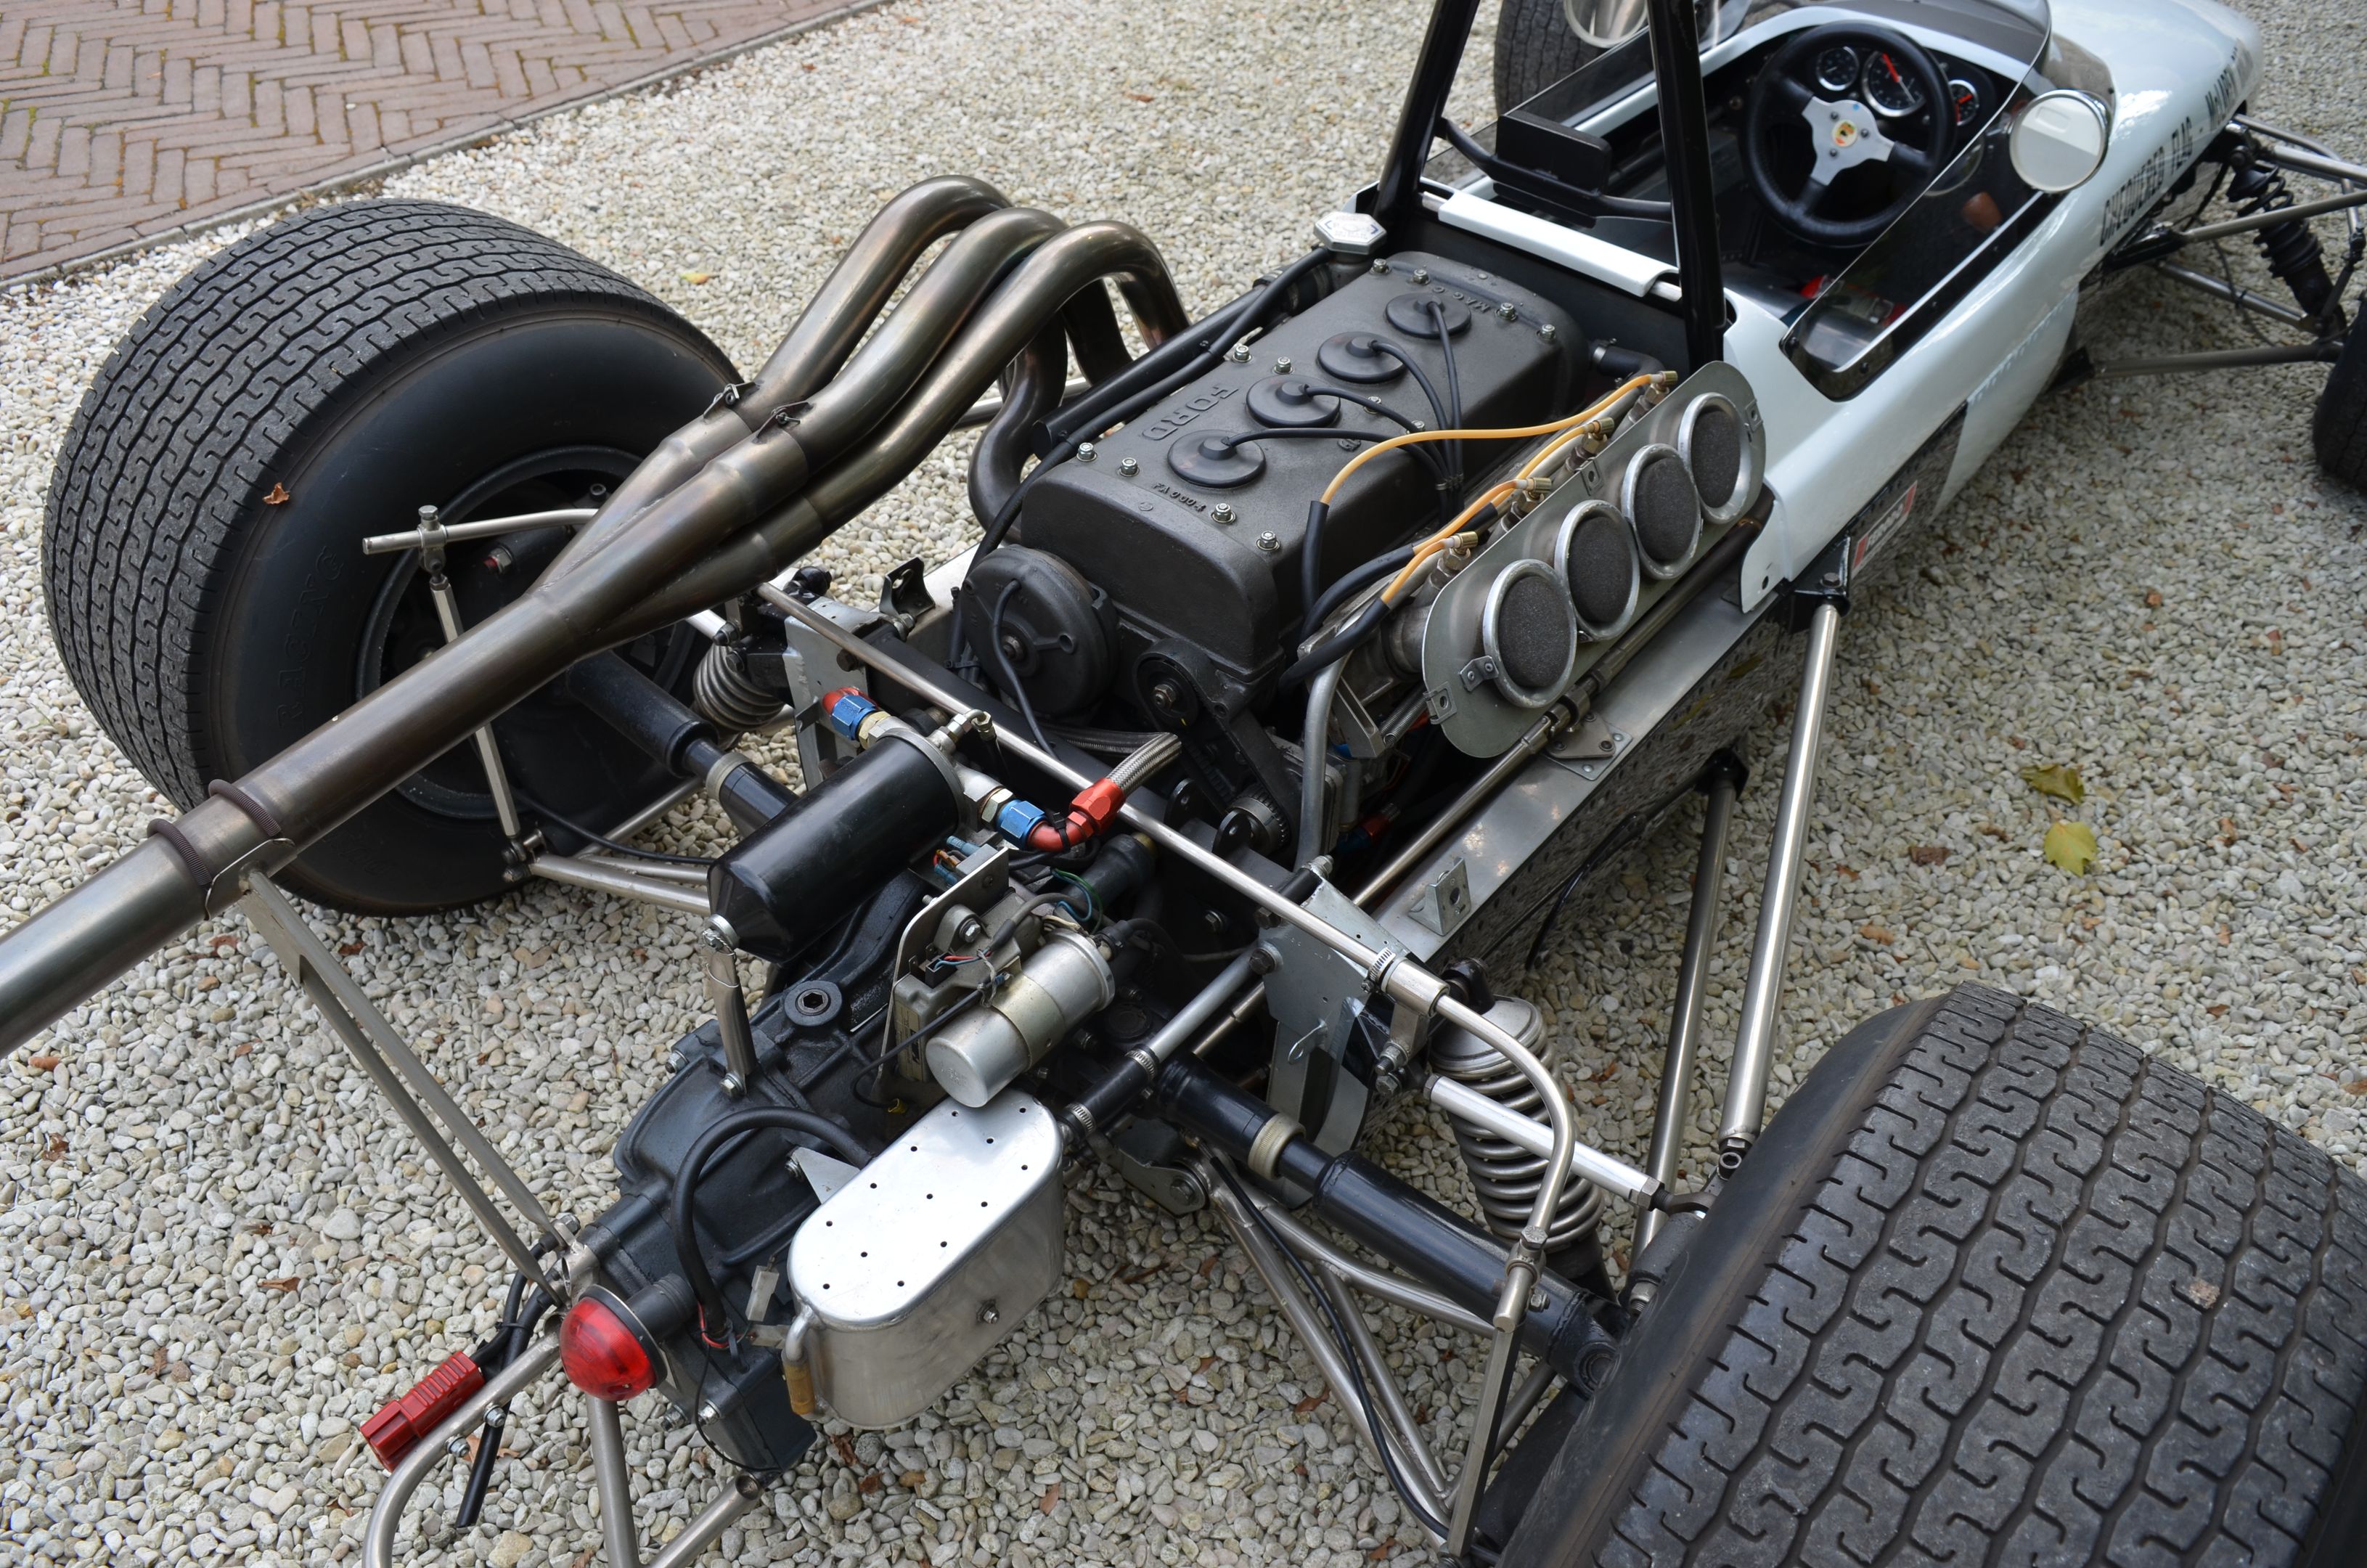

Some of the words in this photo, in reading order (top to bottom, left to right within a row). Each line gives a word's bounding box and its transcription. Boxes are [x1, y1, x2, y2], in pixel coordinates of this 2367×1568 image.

[1452, 292, 1491, 314] MAG
[1141, 385, 1239, 441] FORD
[277, 546, 345, 729] RACING
